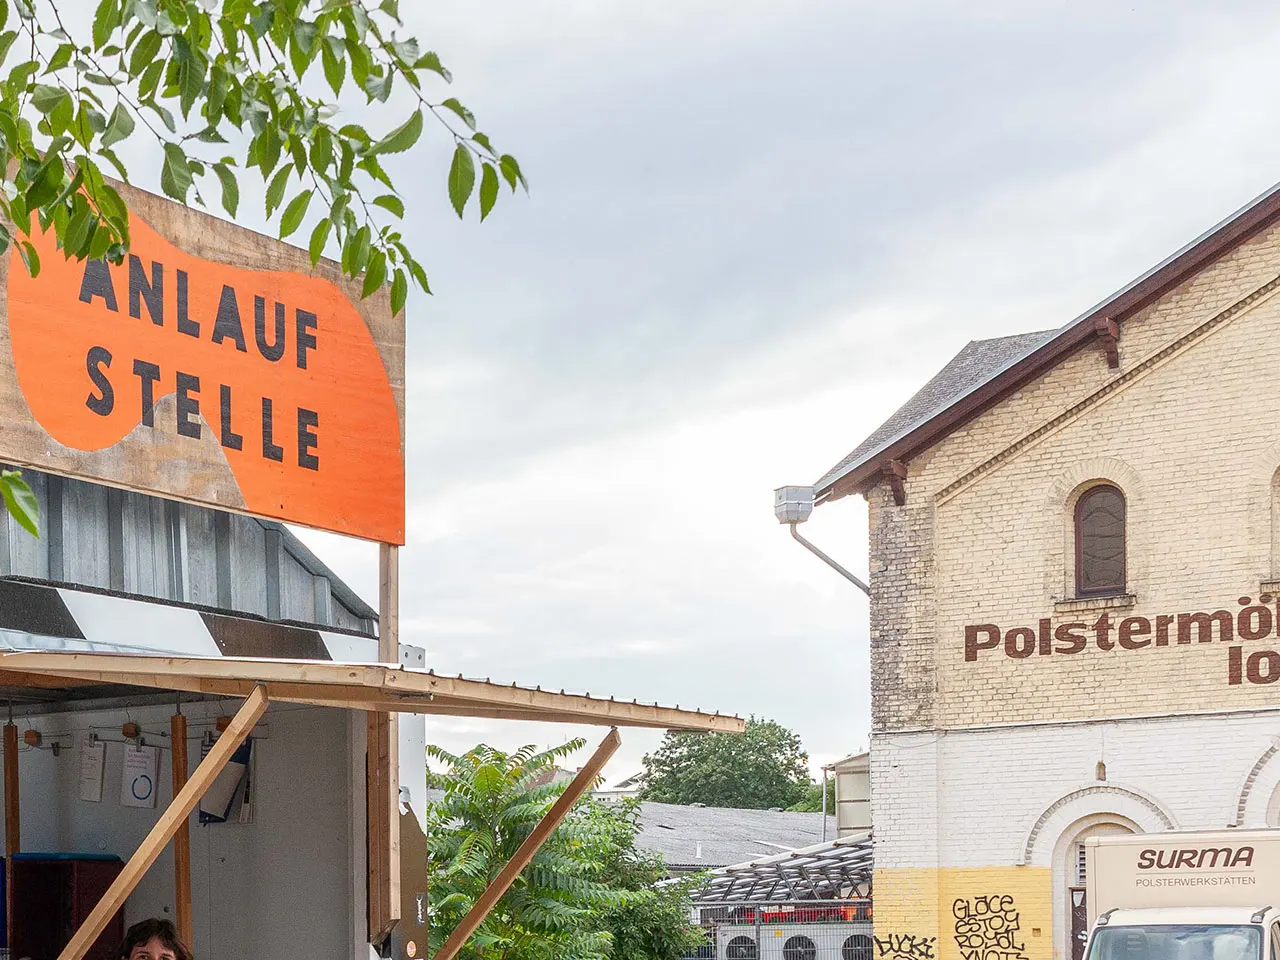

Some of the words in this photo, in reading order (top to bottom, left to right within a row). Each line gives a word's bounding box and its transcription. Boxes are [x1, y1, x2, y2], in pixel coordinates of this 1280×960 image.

[78, 251, 318, 370] ANLAUF
[85, 345, 319, 471] STELLE
[965, 595, 1280, 662] Polstermö
[1135, 876, 1256, 887] POLSTERWERKSTÄTTEN
[1137, 846, 1255, 869] SURMA
